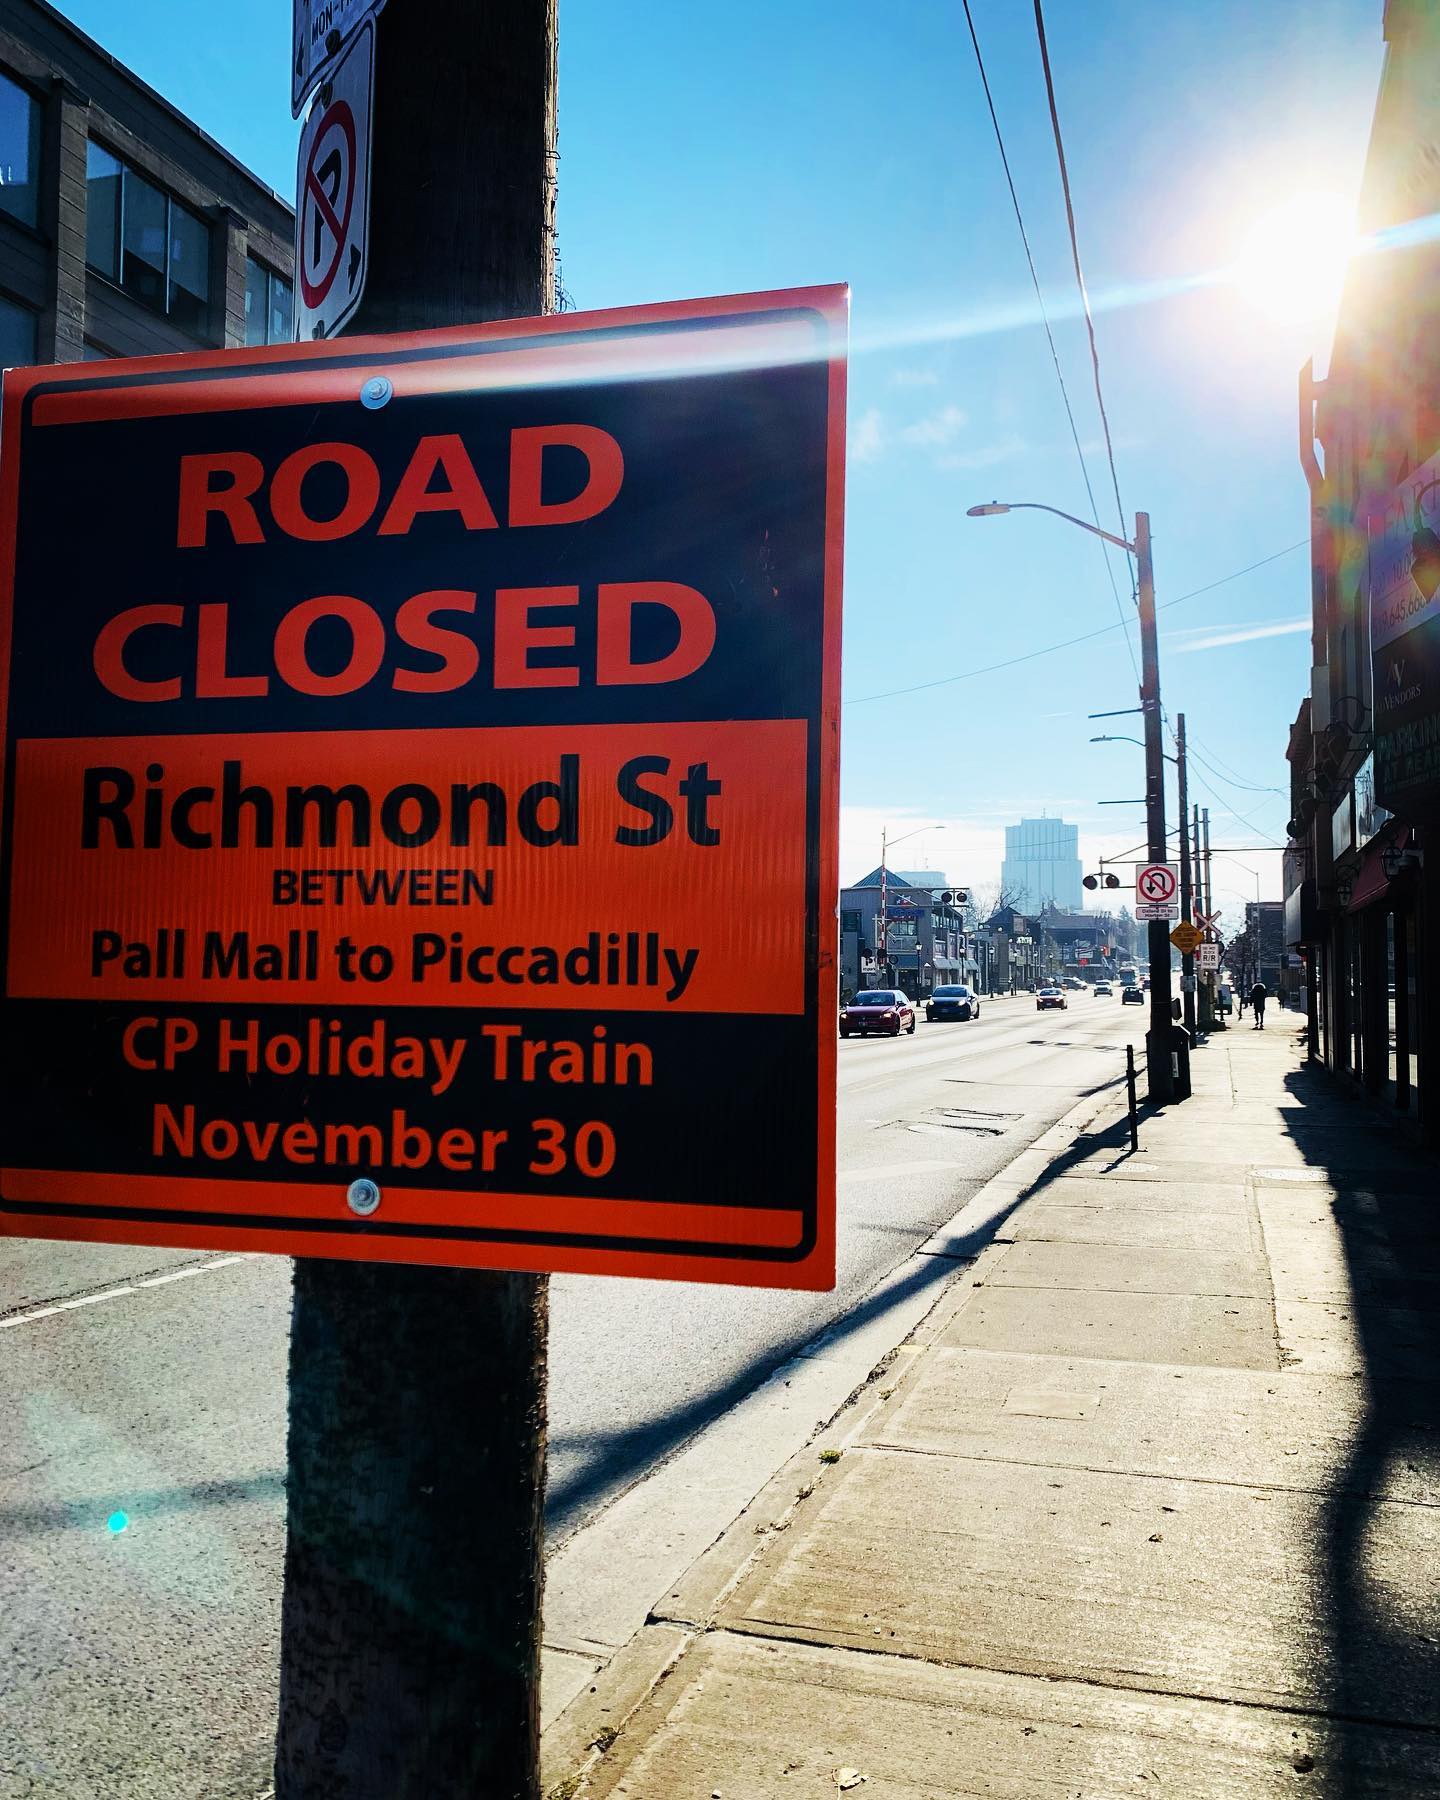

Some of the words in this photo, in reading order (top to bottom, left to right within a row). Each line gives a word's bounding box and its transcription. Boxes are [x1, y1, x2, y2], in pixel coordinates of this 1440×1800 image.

[177, 424, 625, 548] ROAD
[93, 581, 717, 703] CLOSED
[82, 754, 580, 850] Richmond
[615, 755, 722, 847] St
[272, 869, 495, 907] BETWEEN
[91, 930, 185, 980] Pall
[201, 929, 319, 982] Mall
[335, 936, 394, 983] to
[412, 931, 700, 1002] Piccadilly
[123, 1018, 197, 1070] CP
[219, 1018, 467, 1095] Holiday
[482, 1025, 654, 1086] Train
[153, 1104, 508, 1172] November
[529, 1119, 617, 1178] 30
